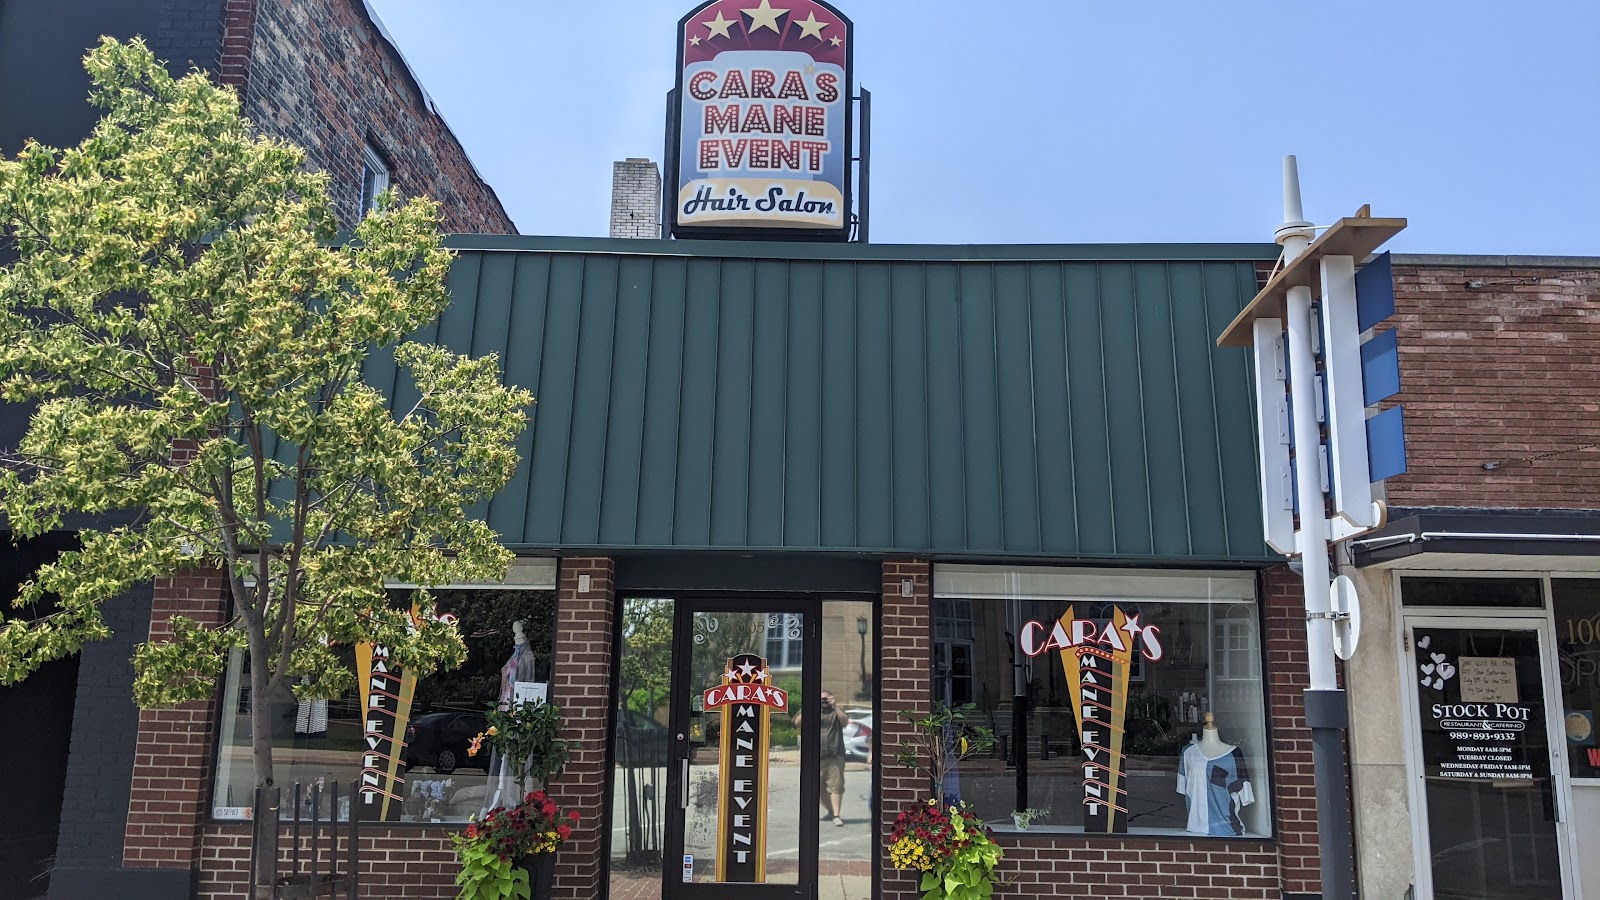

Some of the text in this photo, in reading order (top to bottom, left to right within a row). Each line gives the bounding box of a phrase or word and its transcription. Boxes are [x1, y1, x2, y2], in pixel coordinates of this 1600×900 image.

[704, 104, 826, 137] MANE
[699, 139, 829, 171] EVENT
[683, 185, 835, 215] Hair Salon
[362, 645, 389, 804] MANE EVENT
[1432, 703, 1531, 720] STOCK POT
[1482, 720, 1492, 730] &
[1080, 655, 1101, 816] MANE EVENT
[733, 705, 755, 863] MANE EVENT
